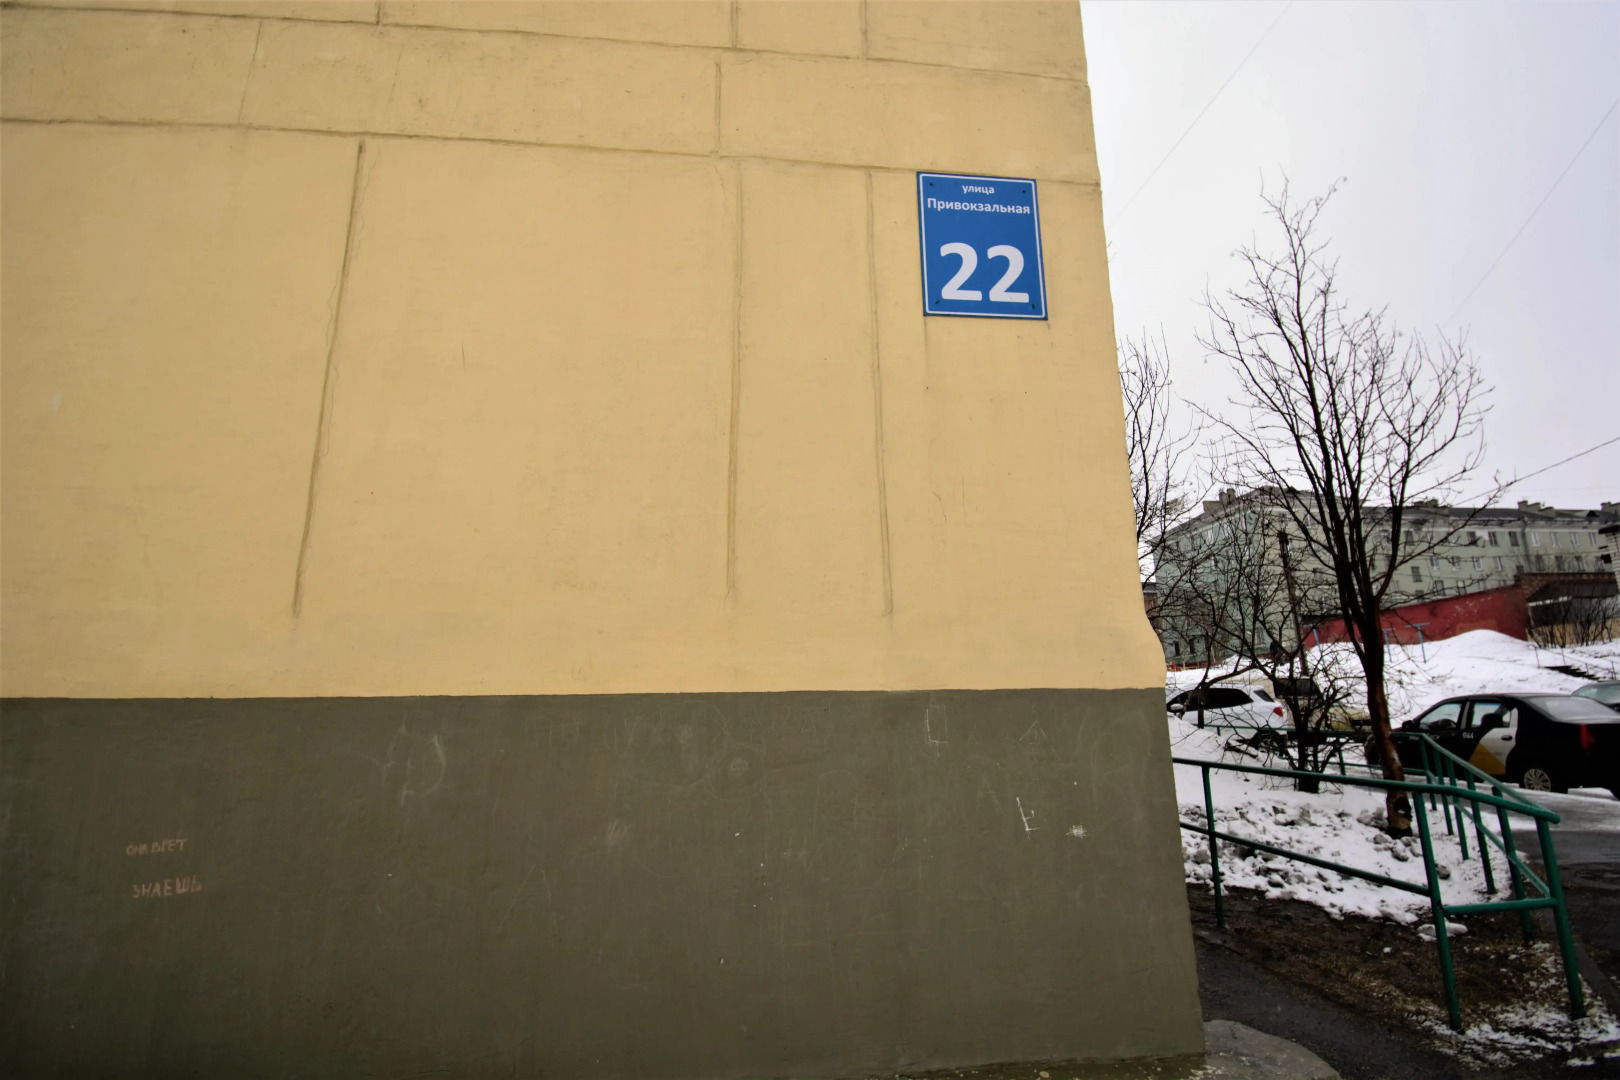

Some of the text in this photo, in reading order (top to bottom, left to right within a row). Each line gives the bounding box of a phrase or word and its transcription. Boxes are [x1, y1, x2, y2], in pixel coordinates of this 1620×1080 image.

[962, 184, 995, 195] улица
[927, 198, 1031, 215] Привокзальная
[940, 242, 1030, 303] 22
